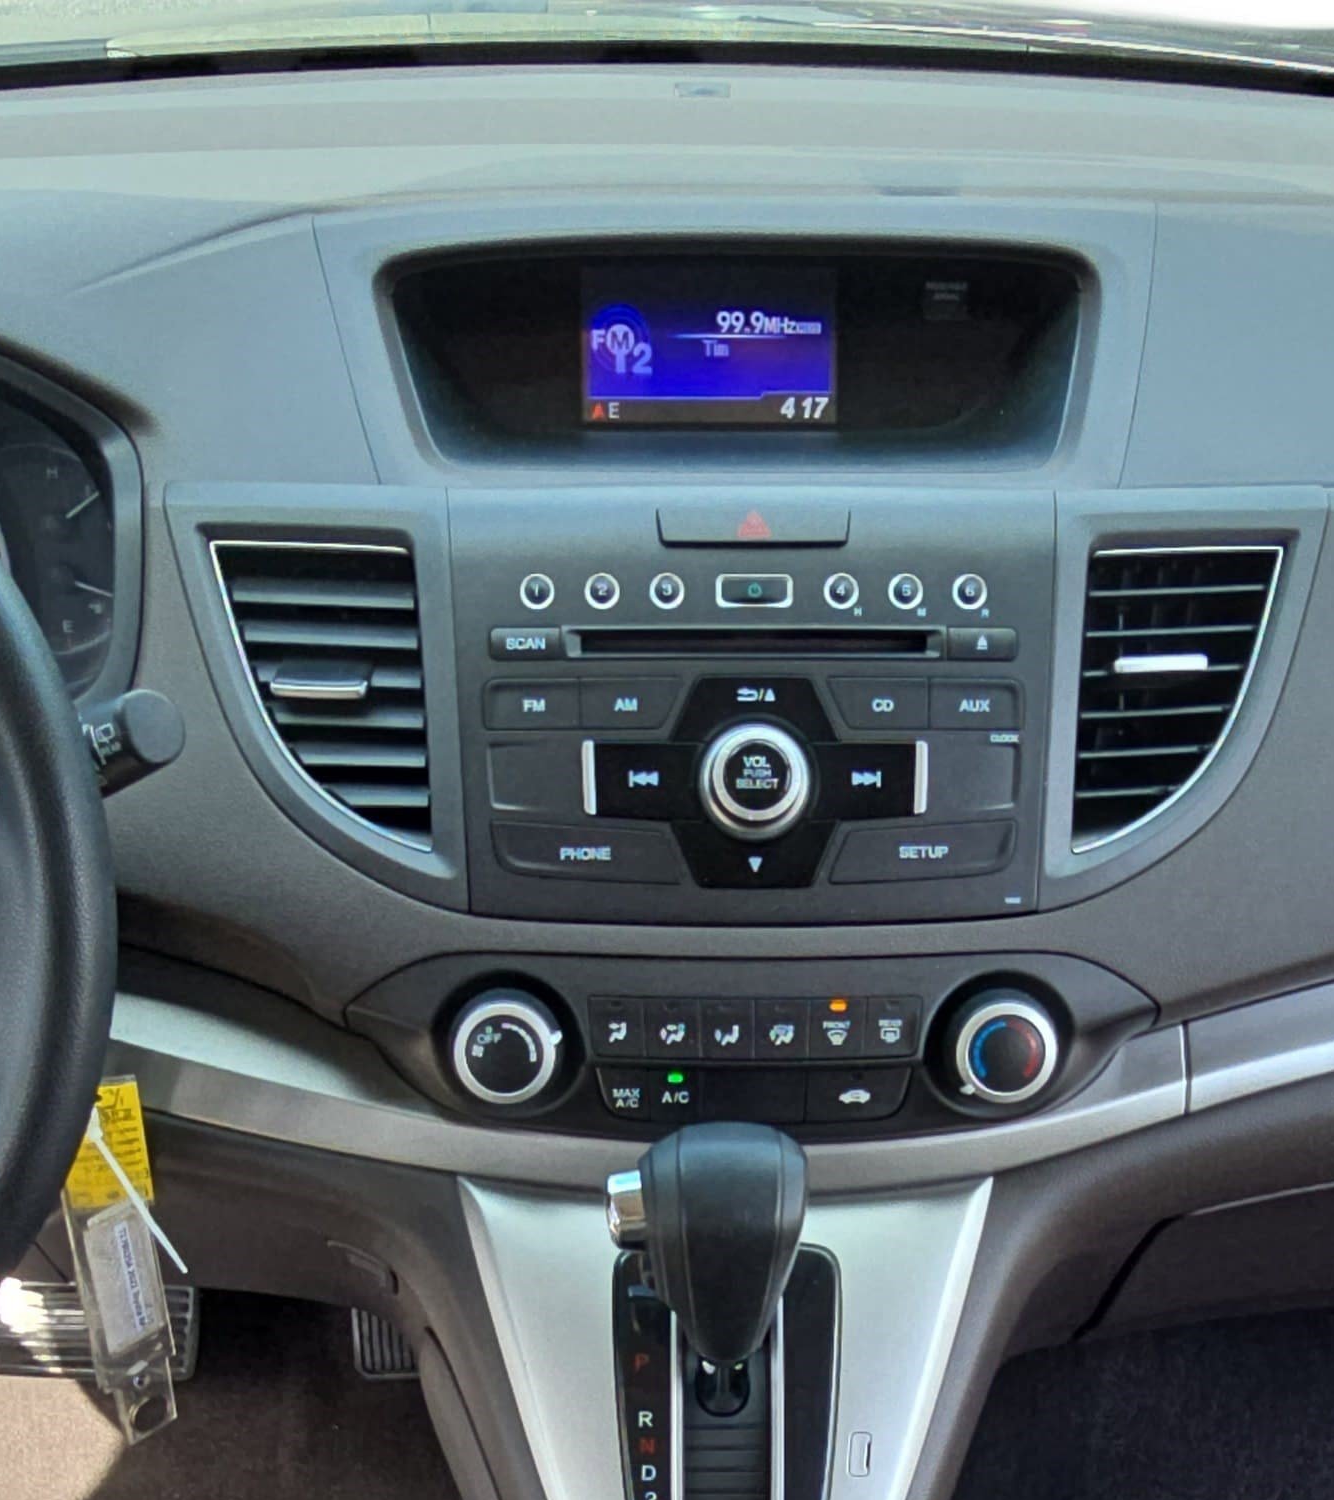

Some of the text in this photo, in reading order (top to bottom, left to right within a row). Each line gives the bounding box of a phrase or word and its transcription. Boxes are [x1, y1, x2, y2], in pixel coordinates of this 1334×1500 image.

[597, 583, 608, 596] 2
[835, 584, 847, 597] 4
[505, 637, 546, 650] SCAN
[522, 699, 546, 712] FM
[613, 698, 638, 712] AM
[871, 698, 895, 712] CD
[959, 699, 991, 712] AUX
[743, 755, 771, 768] VOL
[560, 846, 612, 862] PHONE
[898, 845, 950, 860] SETUP
[612, 1087, 640, 1098] MAX
[661, 1091, 690, 1104] A/C
[635, 1353, 650, 1371] P
[638, 1411, 654, 1427] R
[639, 1439, 655, 1455] N
[641, 1464, 657, 1481] D
